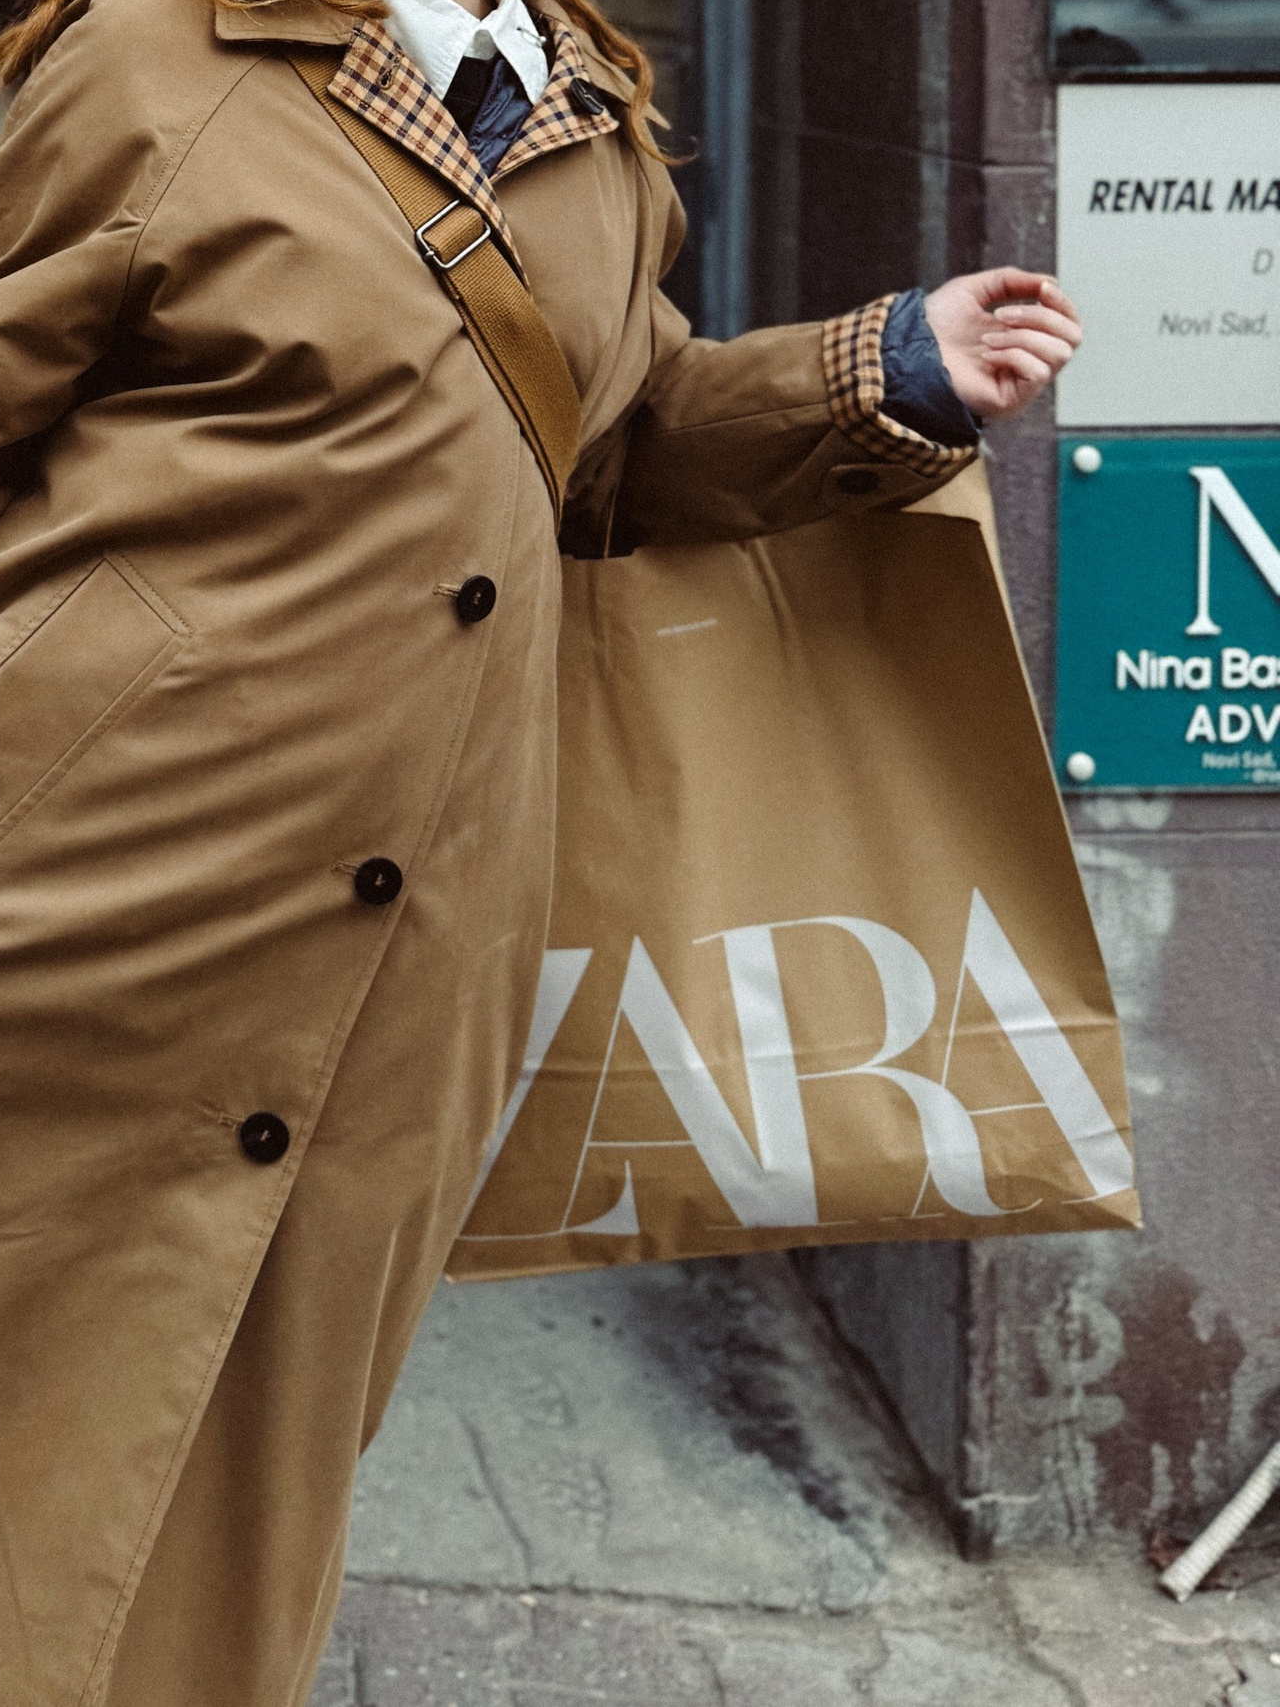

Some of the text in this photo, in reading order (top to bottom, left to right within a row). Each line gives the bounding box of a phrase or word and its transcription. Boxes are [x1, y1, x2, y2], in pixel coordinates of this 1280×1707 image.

[1088, 178, 1280, 213] RENTAL MA
[1158, 311, 1214, 336] Novi
[1115, 649, 1213, 690] Nina
[1185, 703, 1280, 744] ADV
[458, 886, 1134, 1236] ZARA
